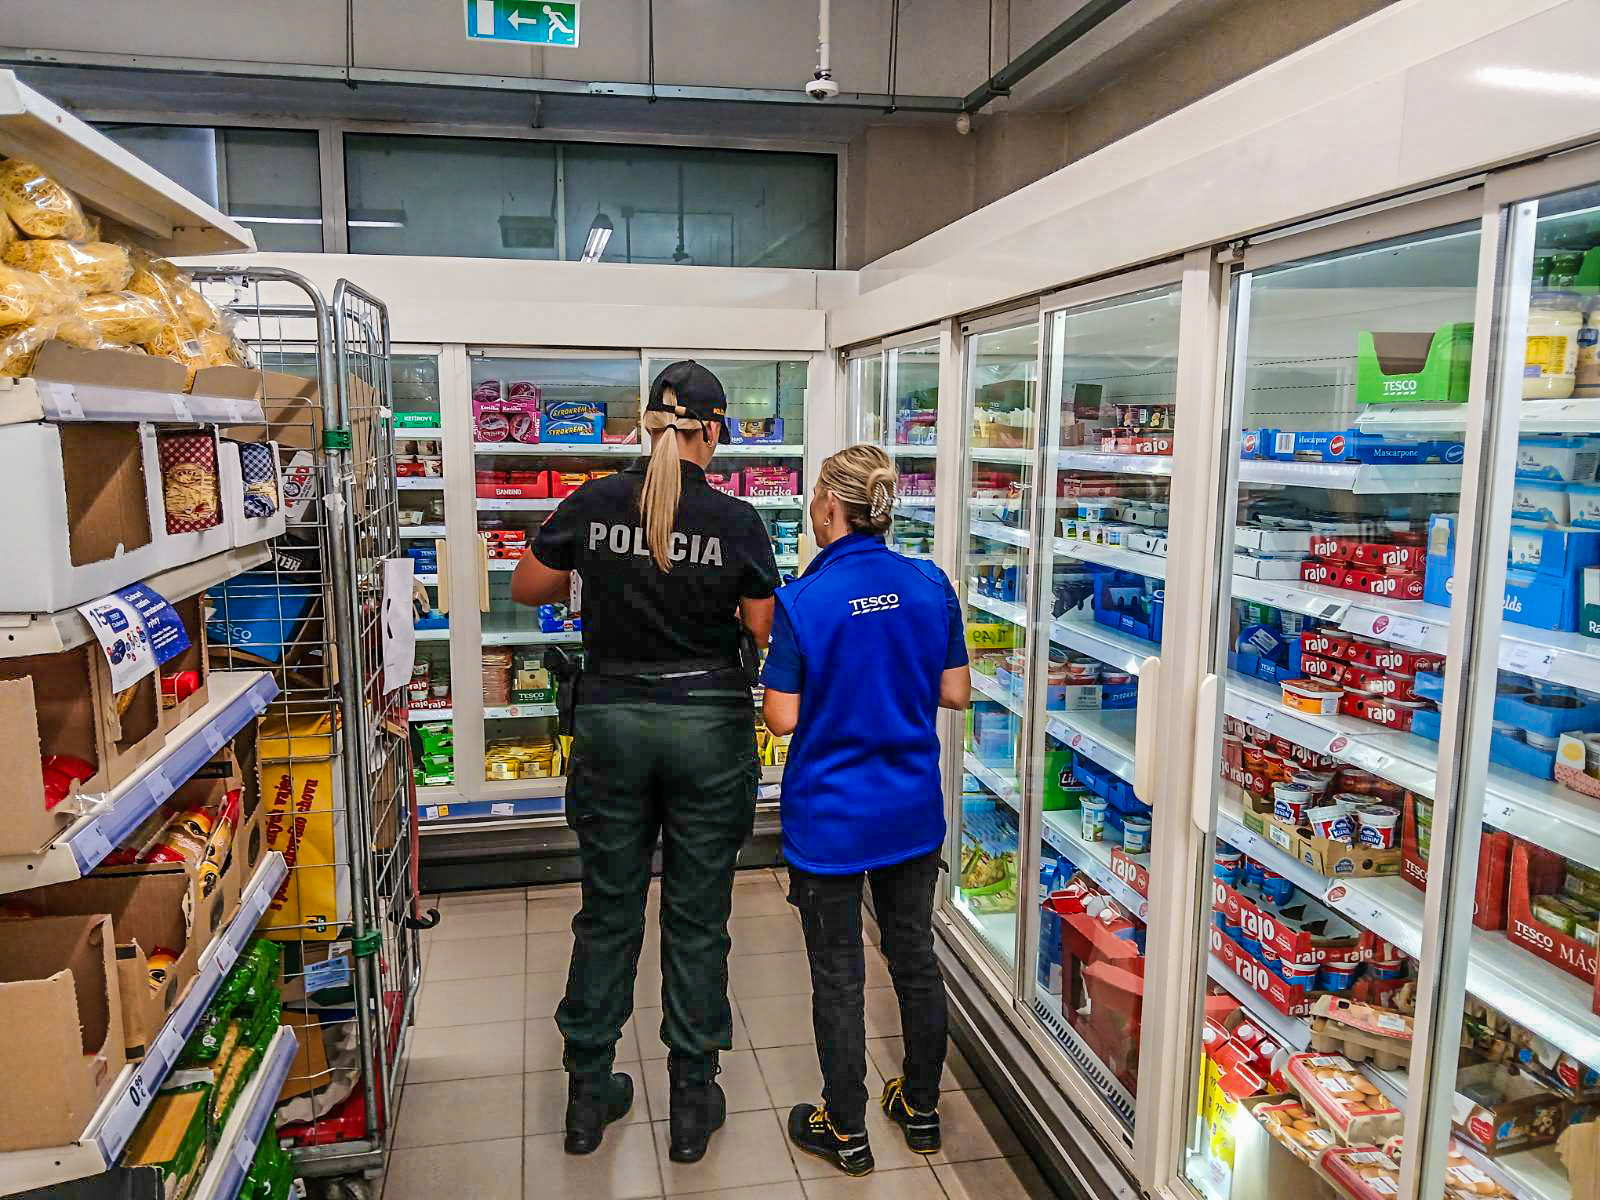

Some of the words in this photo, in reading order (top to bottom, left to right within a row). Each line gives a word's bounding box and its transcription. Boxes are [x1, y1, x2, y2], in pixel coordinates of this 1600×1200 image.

[1384, 380, 1417, 392] TESCO
[1136, 438, 1168, 453] rajo
[1374, 448, 1418, 458] Mascarpone
[750, 486, 792, 496] Karička
[589, 522, 723, 567] POLCIA
[1314, 538, 1337, 556] rajo
[1382, 546, 1409, 566] rajo
[1305, 565, 1327, 582] rajo
[1370, 576, 1396, 594] rajo
[849, 593, 899, 612] TESCO
[1305, 636, 1329, 652] rajo
[1305, 658, 1327, 674] rajo
[1375, 650, 1403, 669] rajo
[409, 681, 427, 690] rajo
[1370, 676, 1396, 695] rajo
[411, 700, 428, 709] rajo
[428, 700, 447, 709] rajo
[1367, 704, 1396, 724] rajo
[1231, 767, 1253, 788] rajo
[1112, 857, 1137, 882] rajo
[1241, 907, 1275, 941] rajo
[1209, 923, 1222, 951] jo
[1515, 919, 1553, 948] TESCO
[1296, 948, 1326, 964] rajo
[1344, 946, 1373, 963] rajo
[1236, 956, 1269, 991] rajo
